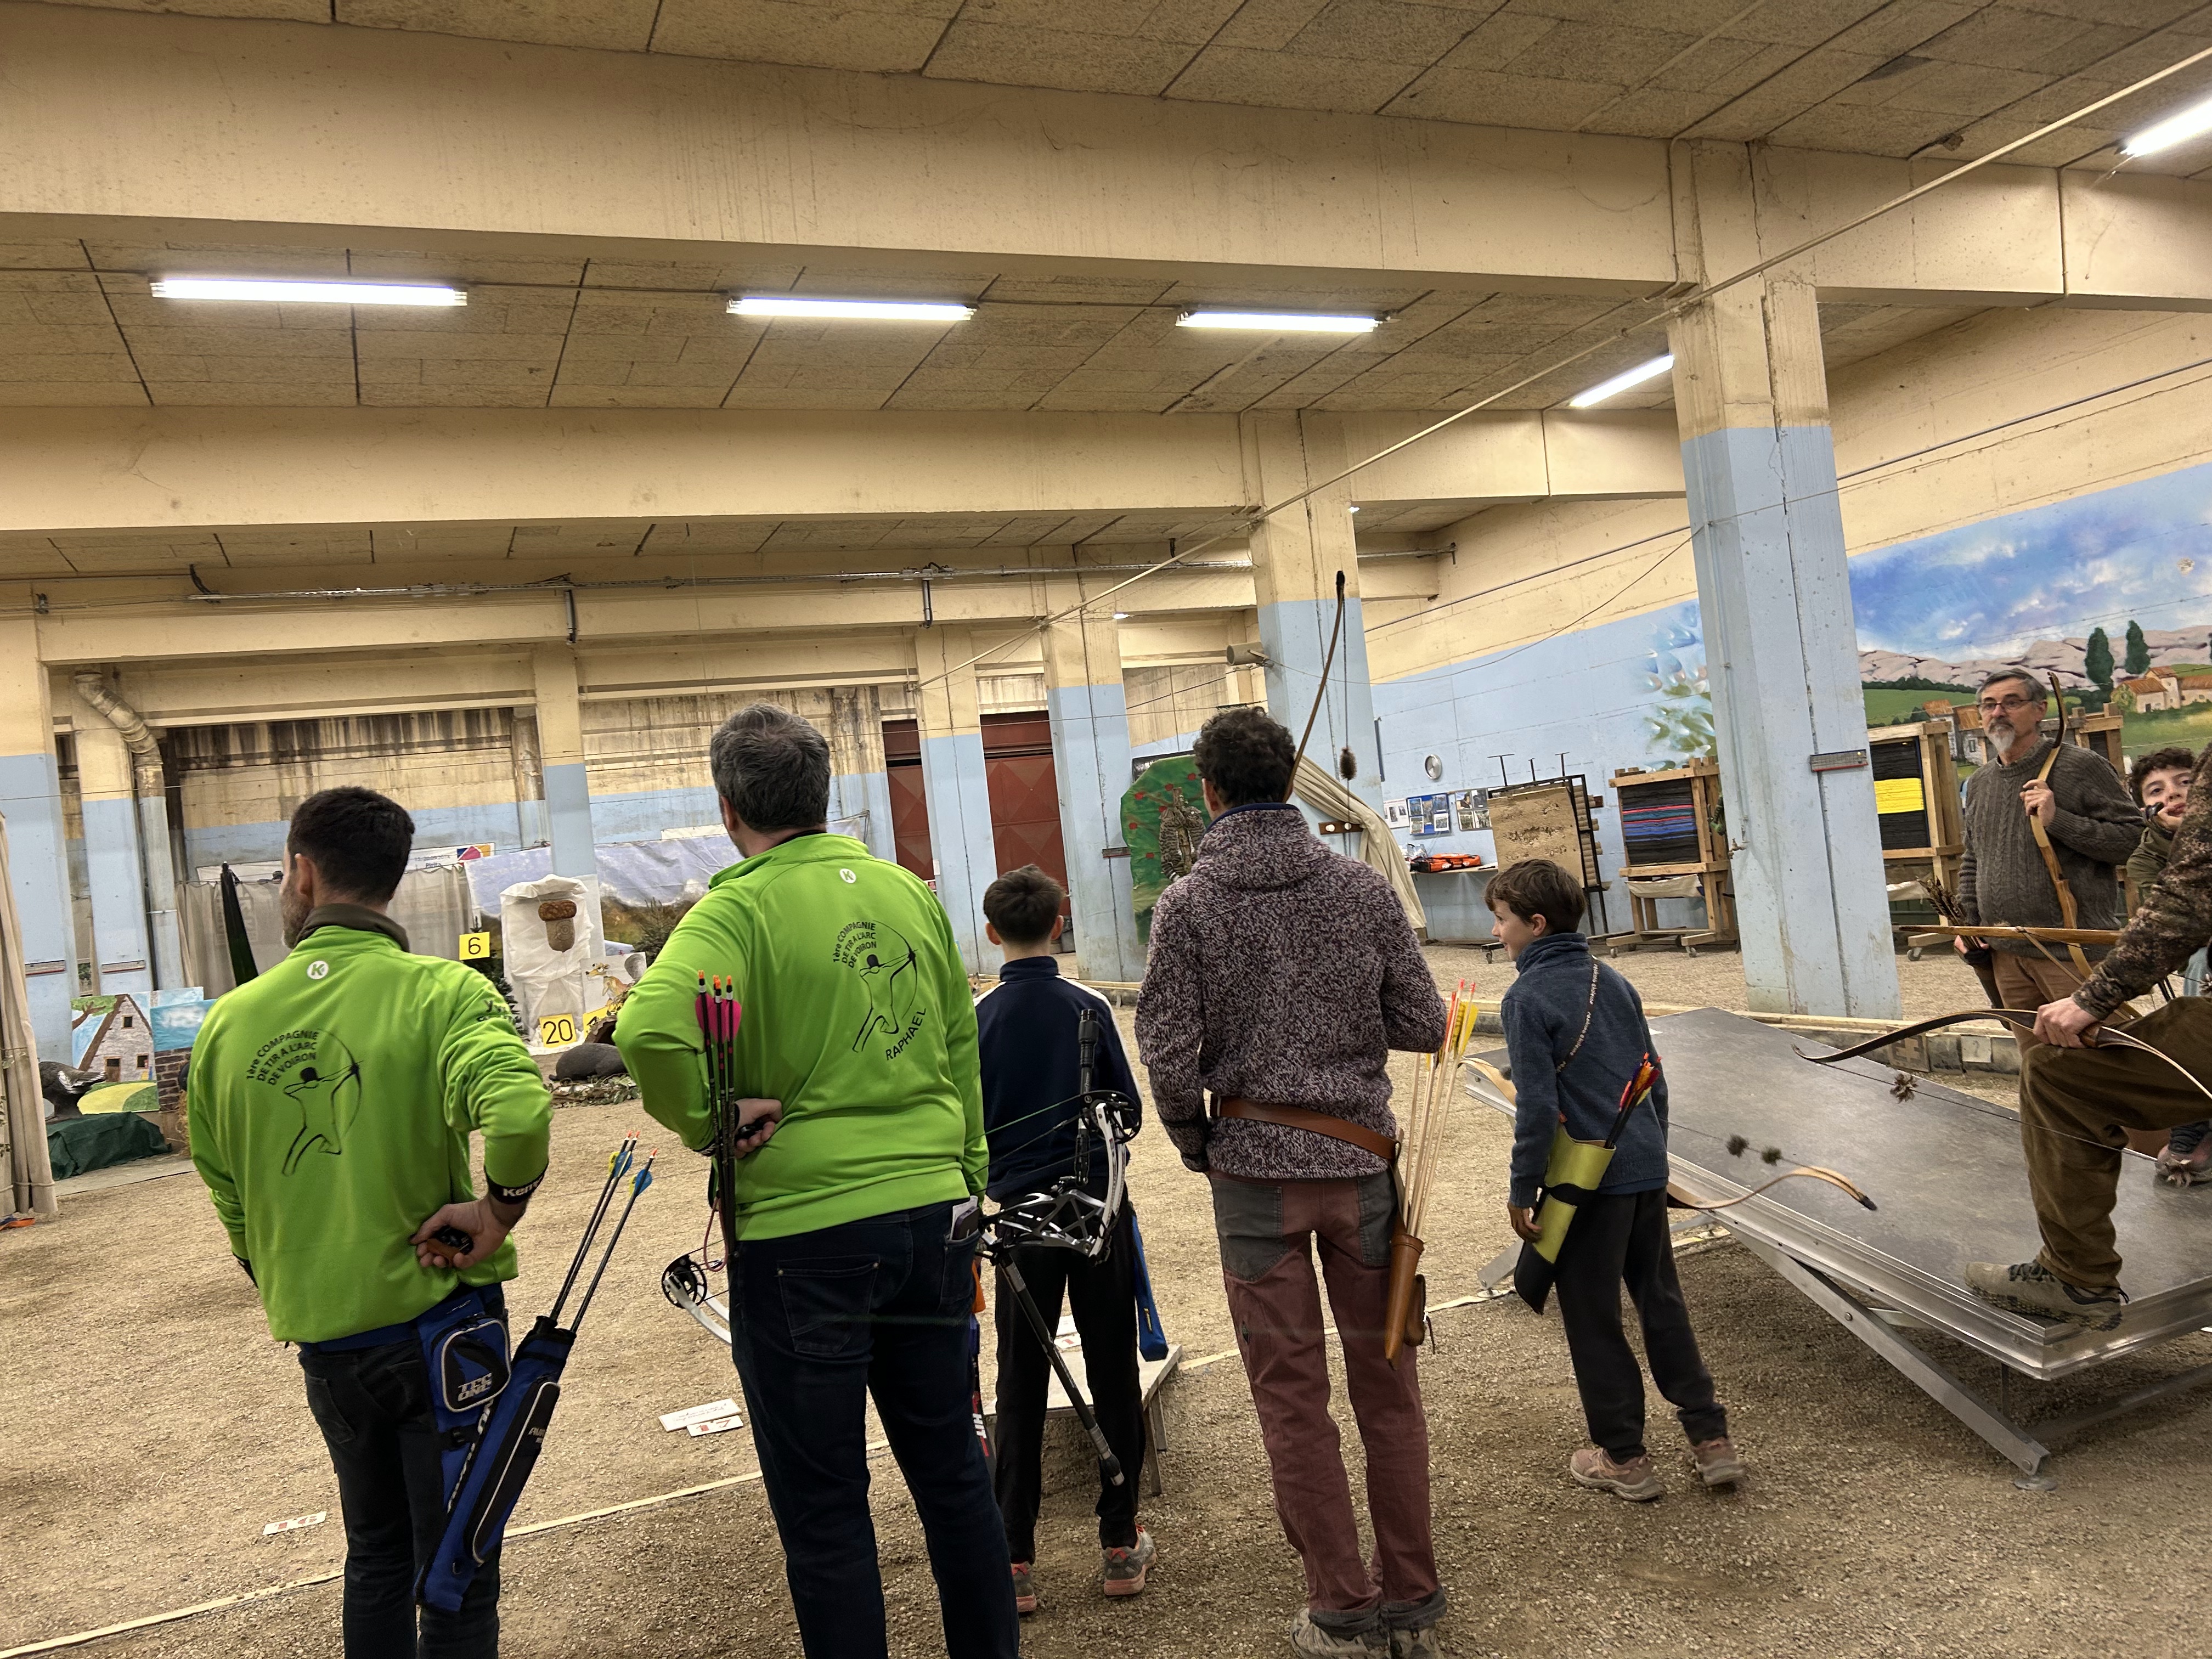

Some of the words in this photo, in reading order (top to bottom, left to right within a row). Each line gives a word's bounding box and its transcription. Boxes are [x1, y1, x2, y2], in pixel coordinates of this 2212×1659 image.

[837, 921, 876, 943] COMPAGNIE
[845, 939, 854, 951] TIR
[856, 932, 876, 940] L'ARC
[468, 936, 481, 955] 6
[842, 951, 849, 963] DE
[848, 955, 857, 968] DE
[853, 941, 877, 957] VOIRON
[257, 1030, 319, 1057] COMPAGNIE
[543, 1019, 573, 1045] 20
[885, 1008, 926, 1060] RAPHAEL
[257, 1067, 269, 1081] DE
[264, 1053, 280, 1067] TIR
[280, 1048, 289, 1057] A
[268, 1072, 281, 1085] DE
[276, 1052, 317, 1073] VOIRON
[972, 1413, 987, 1439] HIT
